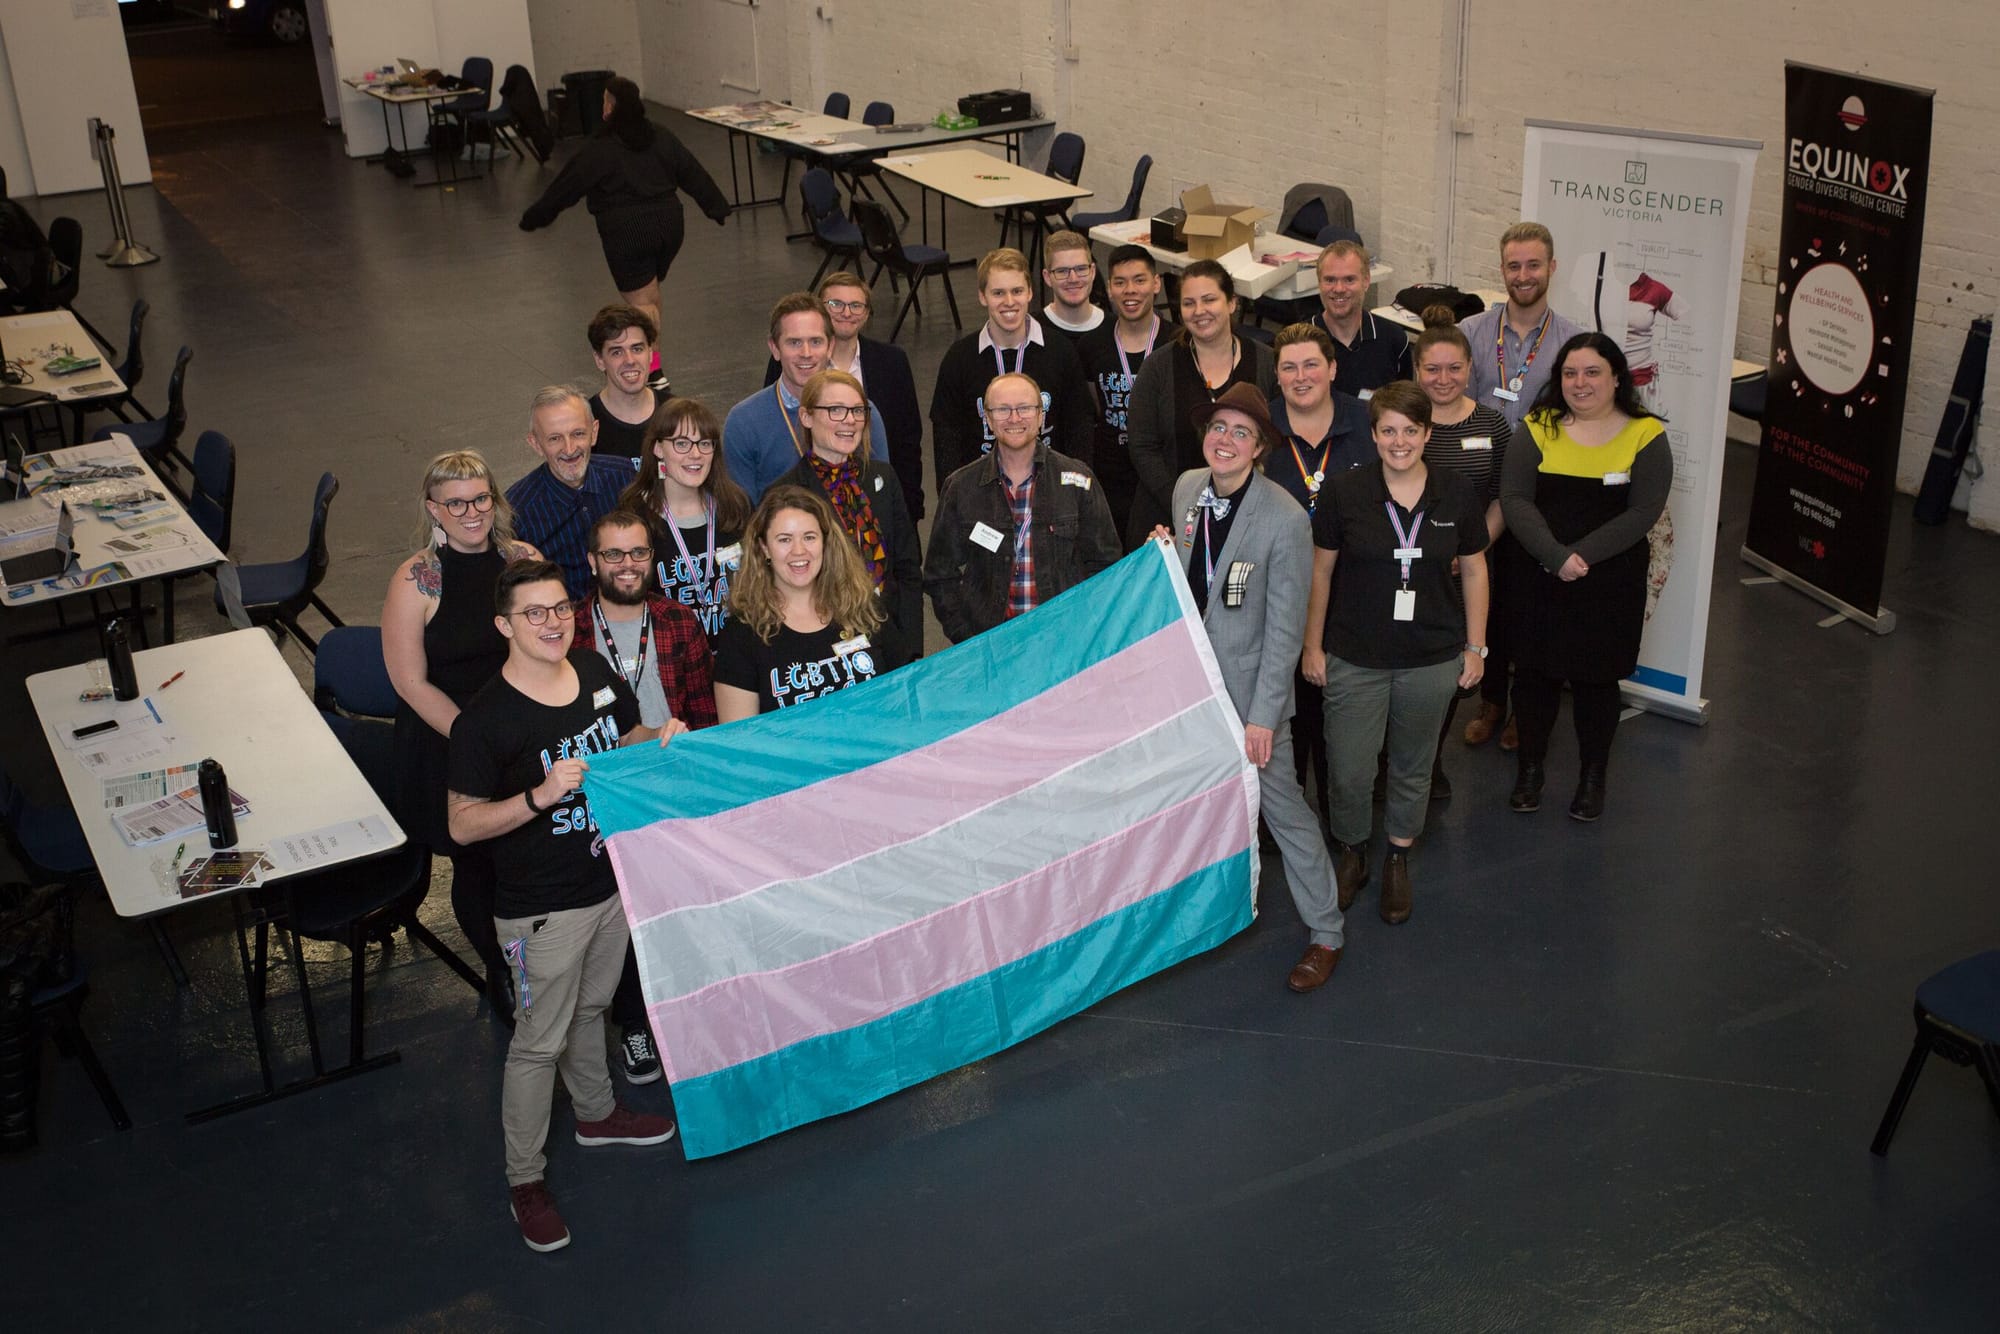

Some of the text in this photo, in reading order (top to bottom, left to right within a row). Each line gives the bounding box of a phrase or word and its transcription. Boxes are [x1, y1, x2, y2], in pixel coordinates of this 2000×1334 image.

[1789, 138, 1910, 200] EQUINOX
[1549, 179, 1724, 217] TRANSGENDER
[1602, 207, 1663, 224] VICTORIA
[1788, 174, 1905, 219] GENDER DIVERSE HEALTH CENTRE
[1799, 293, 1864, 322] WELLBEING SERVICES
[1814, 287, 1853, 306] HEALTH AND
[1769, 425, 1872, 481] FOR THE COMMUNITY
[1772, 440, 1865, 494] BY THE COMMUNITY
[770, 651, 876, 698] LGBTIQ
